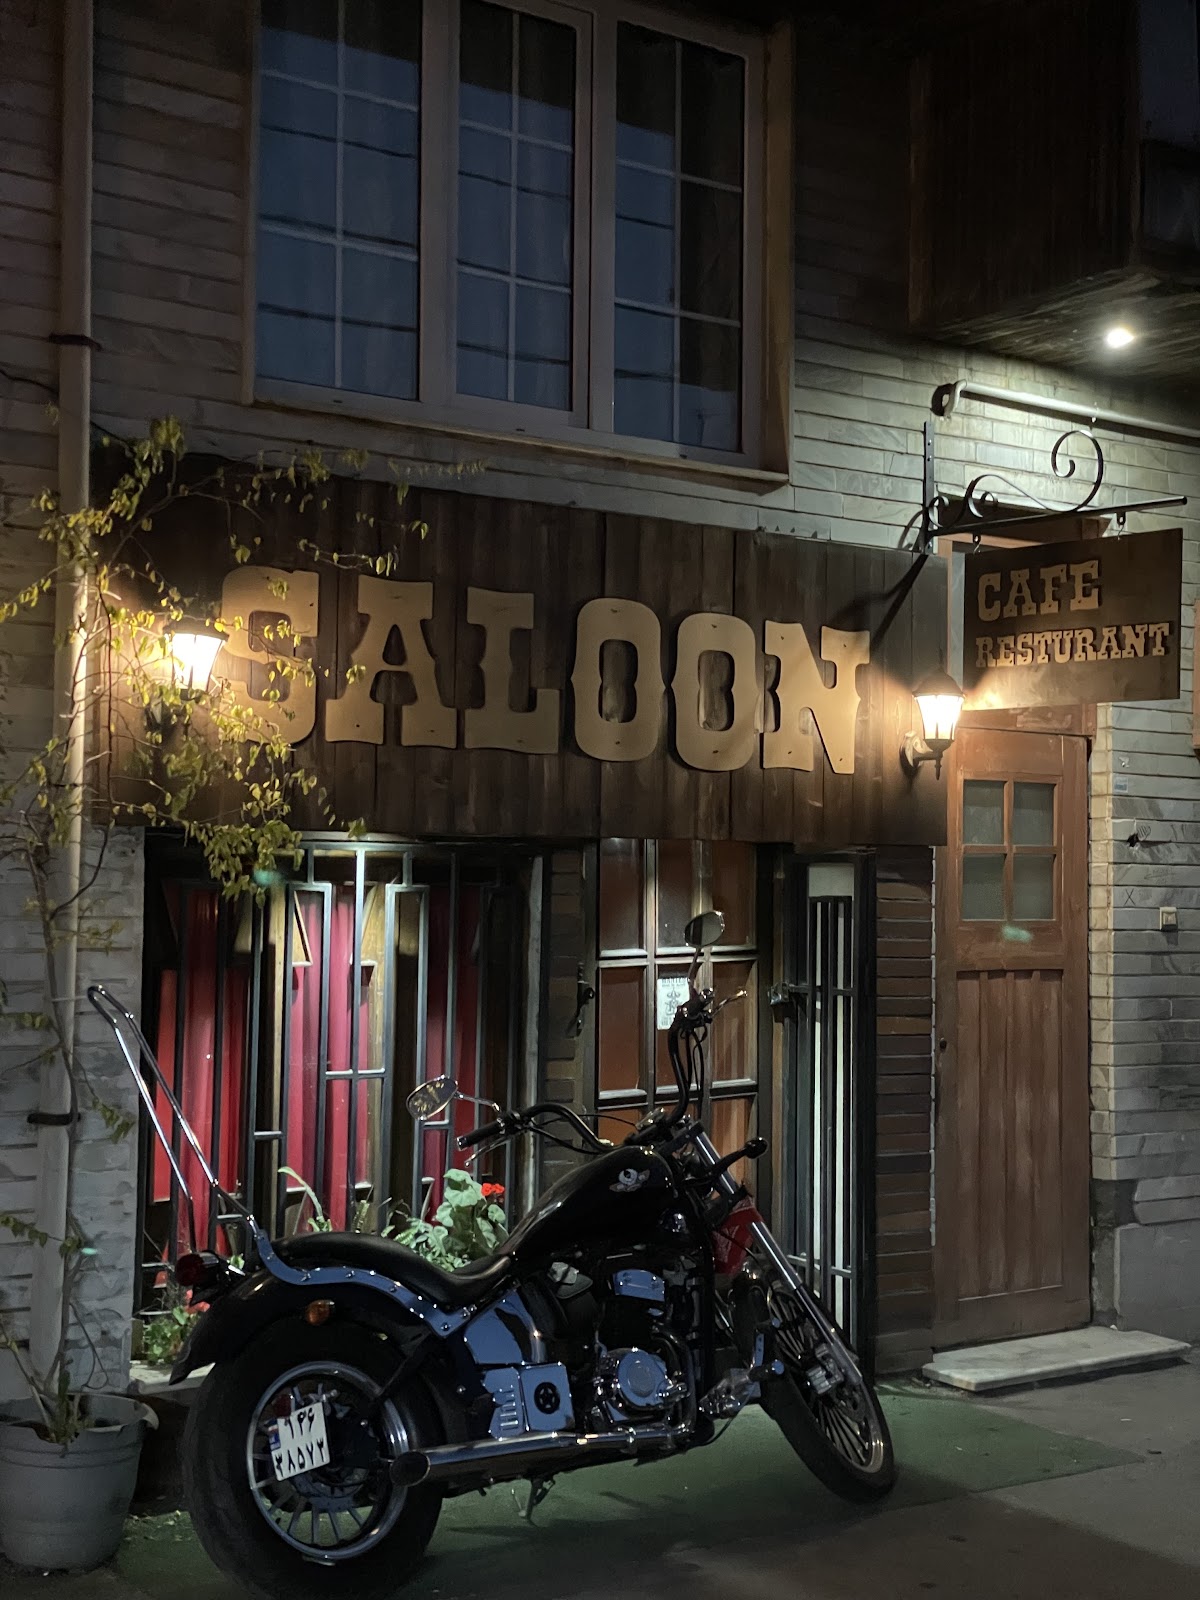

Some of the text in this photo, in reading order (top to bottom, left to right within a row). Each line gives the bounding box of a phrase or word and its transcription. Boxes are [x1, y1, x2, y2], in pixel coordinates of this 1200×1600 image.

[977, 560, 1099, 622] CAFE
[219, 565, 871, 775] SALOON
[975, 622, 1170, 668] RESTURANT
